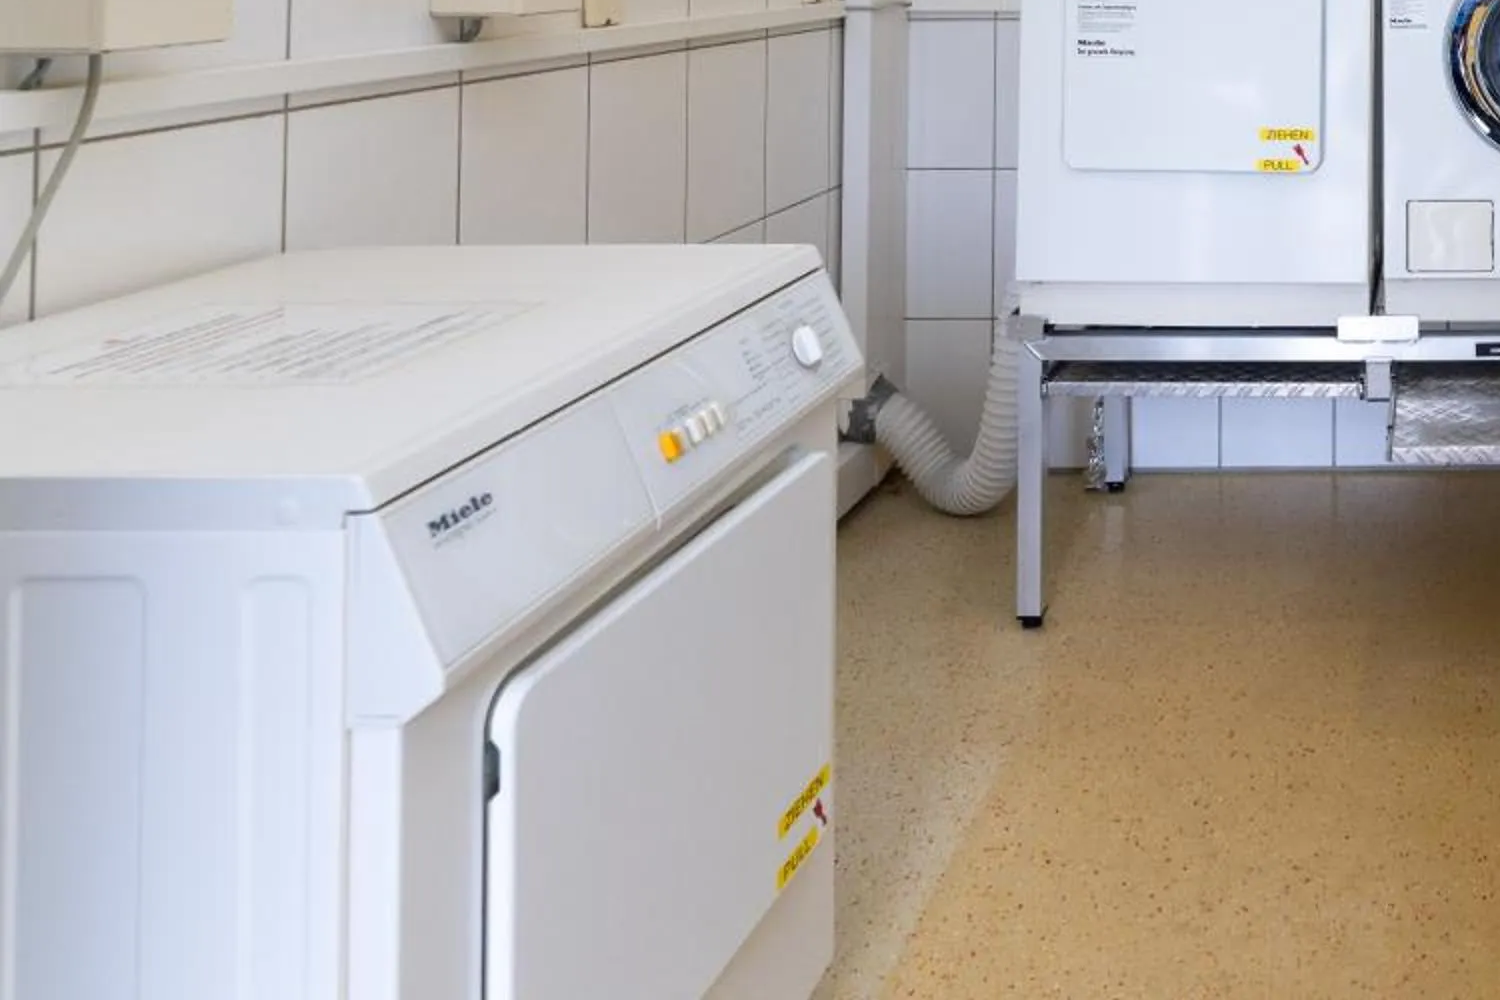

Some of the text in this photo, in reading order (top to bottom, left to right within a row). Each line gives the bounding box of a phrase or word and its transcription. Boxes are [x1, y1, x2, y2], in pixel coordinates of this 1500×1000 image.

[1266, 129, 1310, 141] ZIEHEN
[1263, 160, 1295, 171] PULL
[427, 493, 494, 539] Miele
[784, 775, 824, 831] ZIEHEN
[783, 838, 812, 883] PULL
